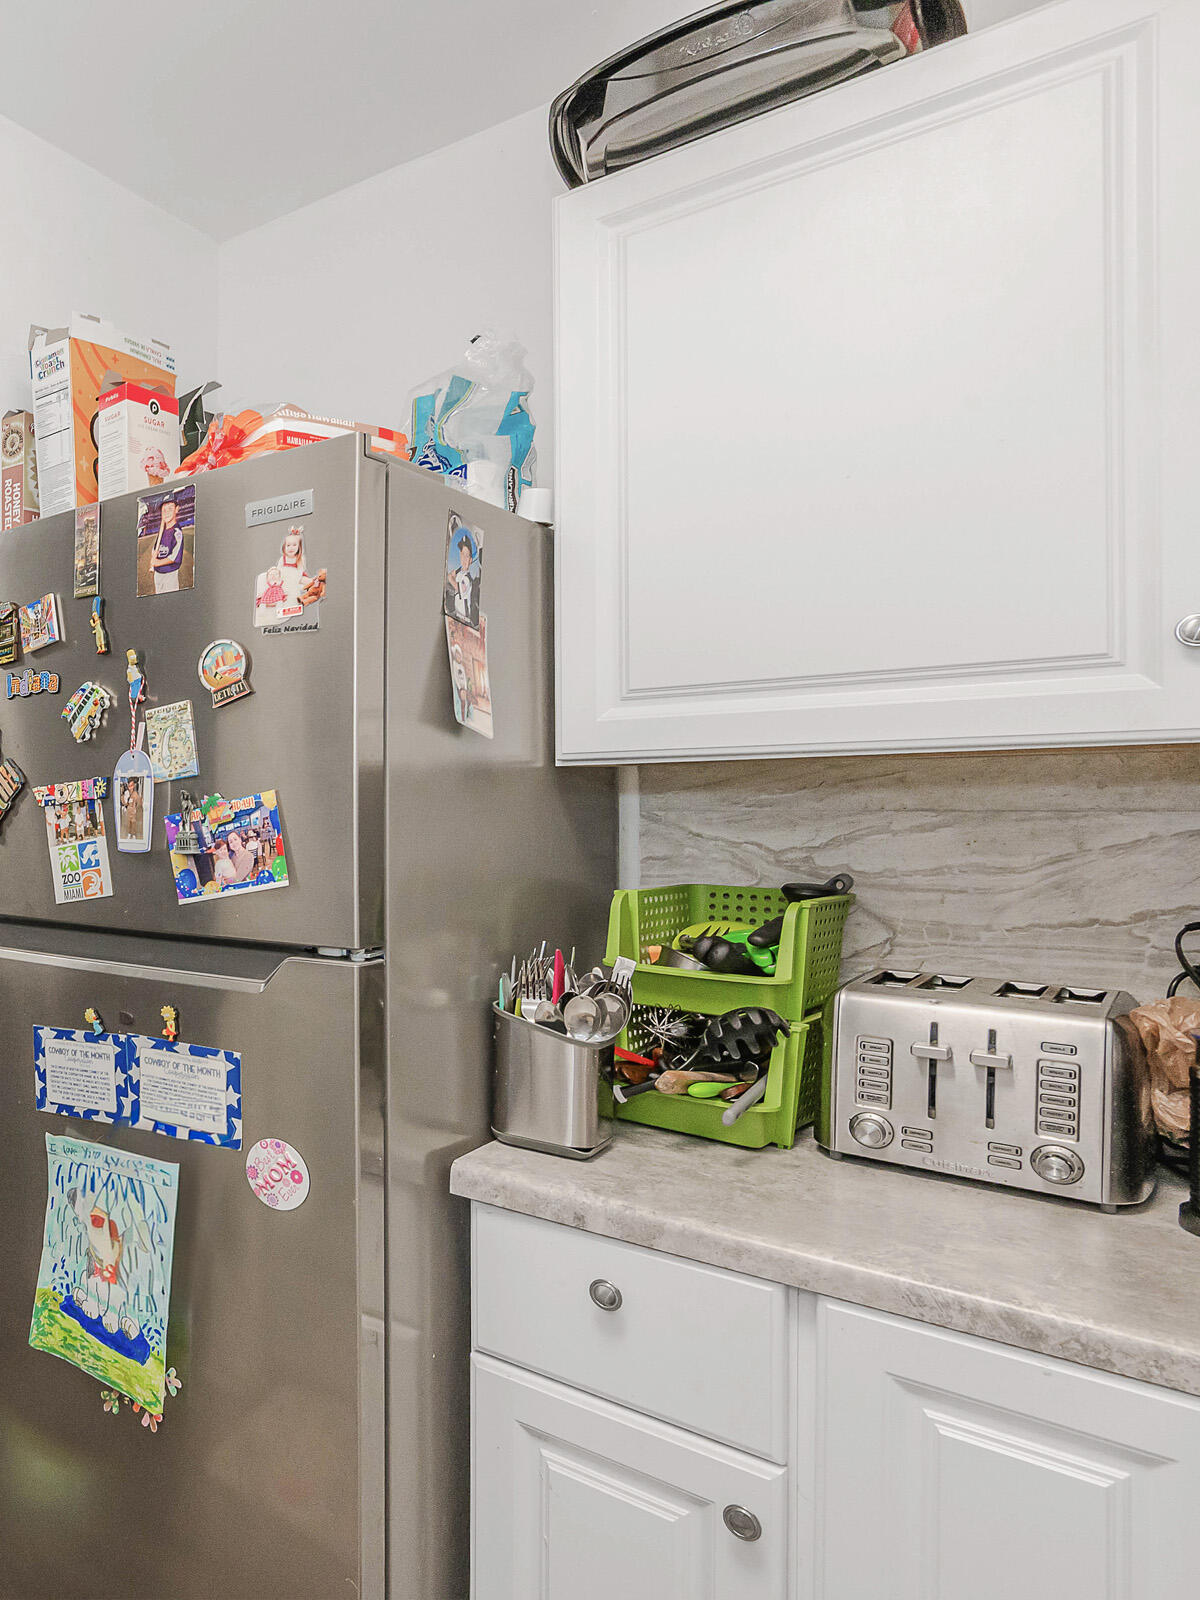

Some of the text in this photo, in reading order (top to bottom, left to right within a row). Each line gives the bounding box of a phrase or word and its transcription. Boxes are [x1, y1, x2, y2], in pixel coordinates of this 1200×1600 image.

[38, 360, 65, 379] Crunch
[104, 411, 121, 422] SUGAR
[144, 416, 165, 428] SUGAR
[12, 482, 21, 523] HONEY
[251, 498, 307, 518] FRIGIDAIRE
[263, 622, 319, 634] Feliz Navidad
[6, 668, 60, 699] Indiana
[61, 872, 81, 885] ZOO
[63, 887, 84, 901] MIAMI
[48, 1046, 111, 1061] COWBOY OF THE MONTH
[144, 1056, 221, 1079] COWBOY OF THE MONTH
[255, 1152, 297, 1197] MOM
[278, 1184, 302, 1202] Ever
